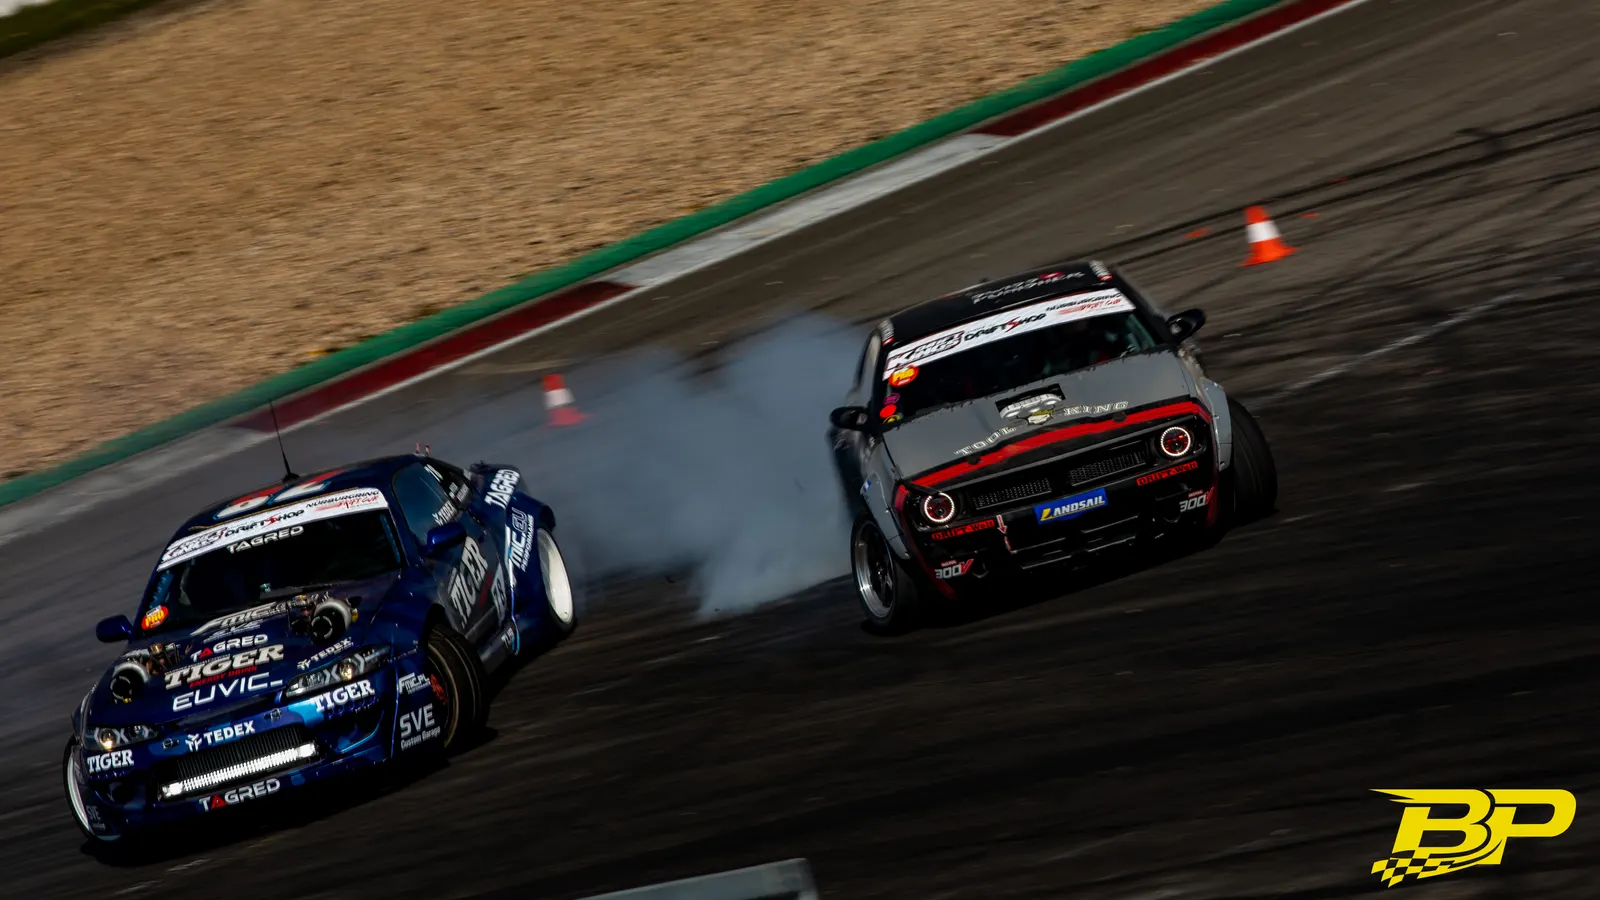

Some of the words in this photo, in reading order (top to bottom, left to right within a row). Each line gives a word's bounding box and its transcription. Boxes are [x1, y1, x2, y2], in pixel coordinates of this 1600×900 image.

[1064, 401, 1129, 417] KING
[484, 469, 520, 510] TAGRED
[1179, 486, 1214, 513] 300V
[1040, 495, 1106, 522] LANDSAIL
[226, 526, 304, 554] TAGRED
[934, 558, 974, 579] 300V
[145, 609, 164, 628] PRO
[190, 634, 268, 662] TAGRED
[310, 636, 351, 662] TEDEX
[164, 644, 284, 690] TIGER
[312, 679, 375, 713] TIGER
[204, 719, 256, 746] TEDEX
[400, 703, 435, 738] SVE
[401, 734, 421, 751] Custom
[422, 725, 441, 742] Garage
[86, 750, 135, 774] TIGER
[199, 778, 281, 812] TAGRED
